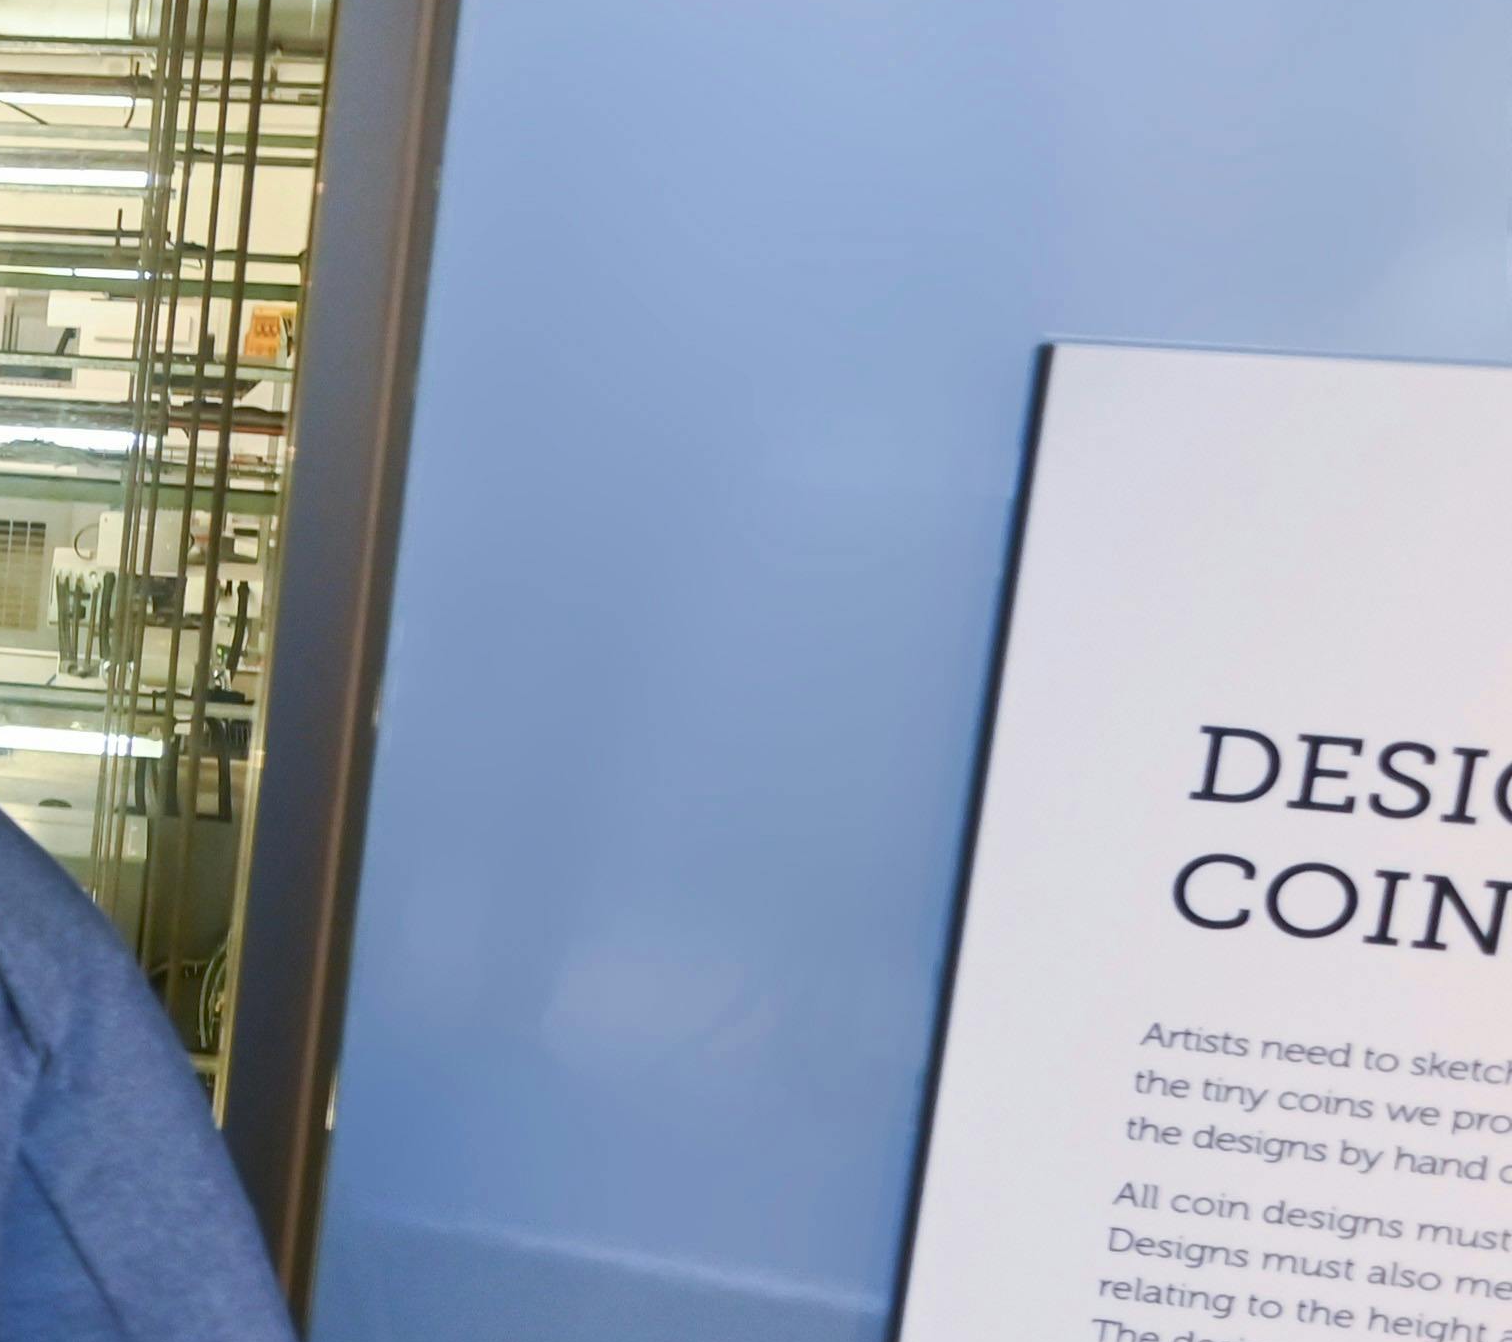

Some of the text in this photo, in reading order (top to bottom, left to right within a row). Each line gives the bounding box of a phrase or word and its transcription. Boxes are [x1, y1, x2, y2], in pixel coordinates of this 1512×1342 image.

[1188, 725, 1512, 824] DESI
[1140, 1022, 1249, 1057] Artists
[1261, 1038, 1352, 1068] need
[1364, 1049, 1399, 1073] to
[1135, 1070, 1512, 1135] the tiny coins we pro
[1126, 1117, 1182, 1146] the
[1193, 1125, 1327, 1163] designs
[1340, 1139, 1384, 1174] by
[1394, 1146, 1489, 1181] hand
[1111, 1181, 1512, 1253] All coin designs must
[1107, 1227, 1512, 1301] Designs must also me
[1098, 1278, 1236, 1319] relating
[1248, 1294, 1282, 1319] to
[1296, 1299, 1354, 1329] the
